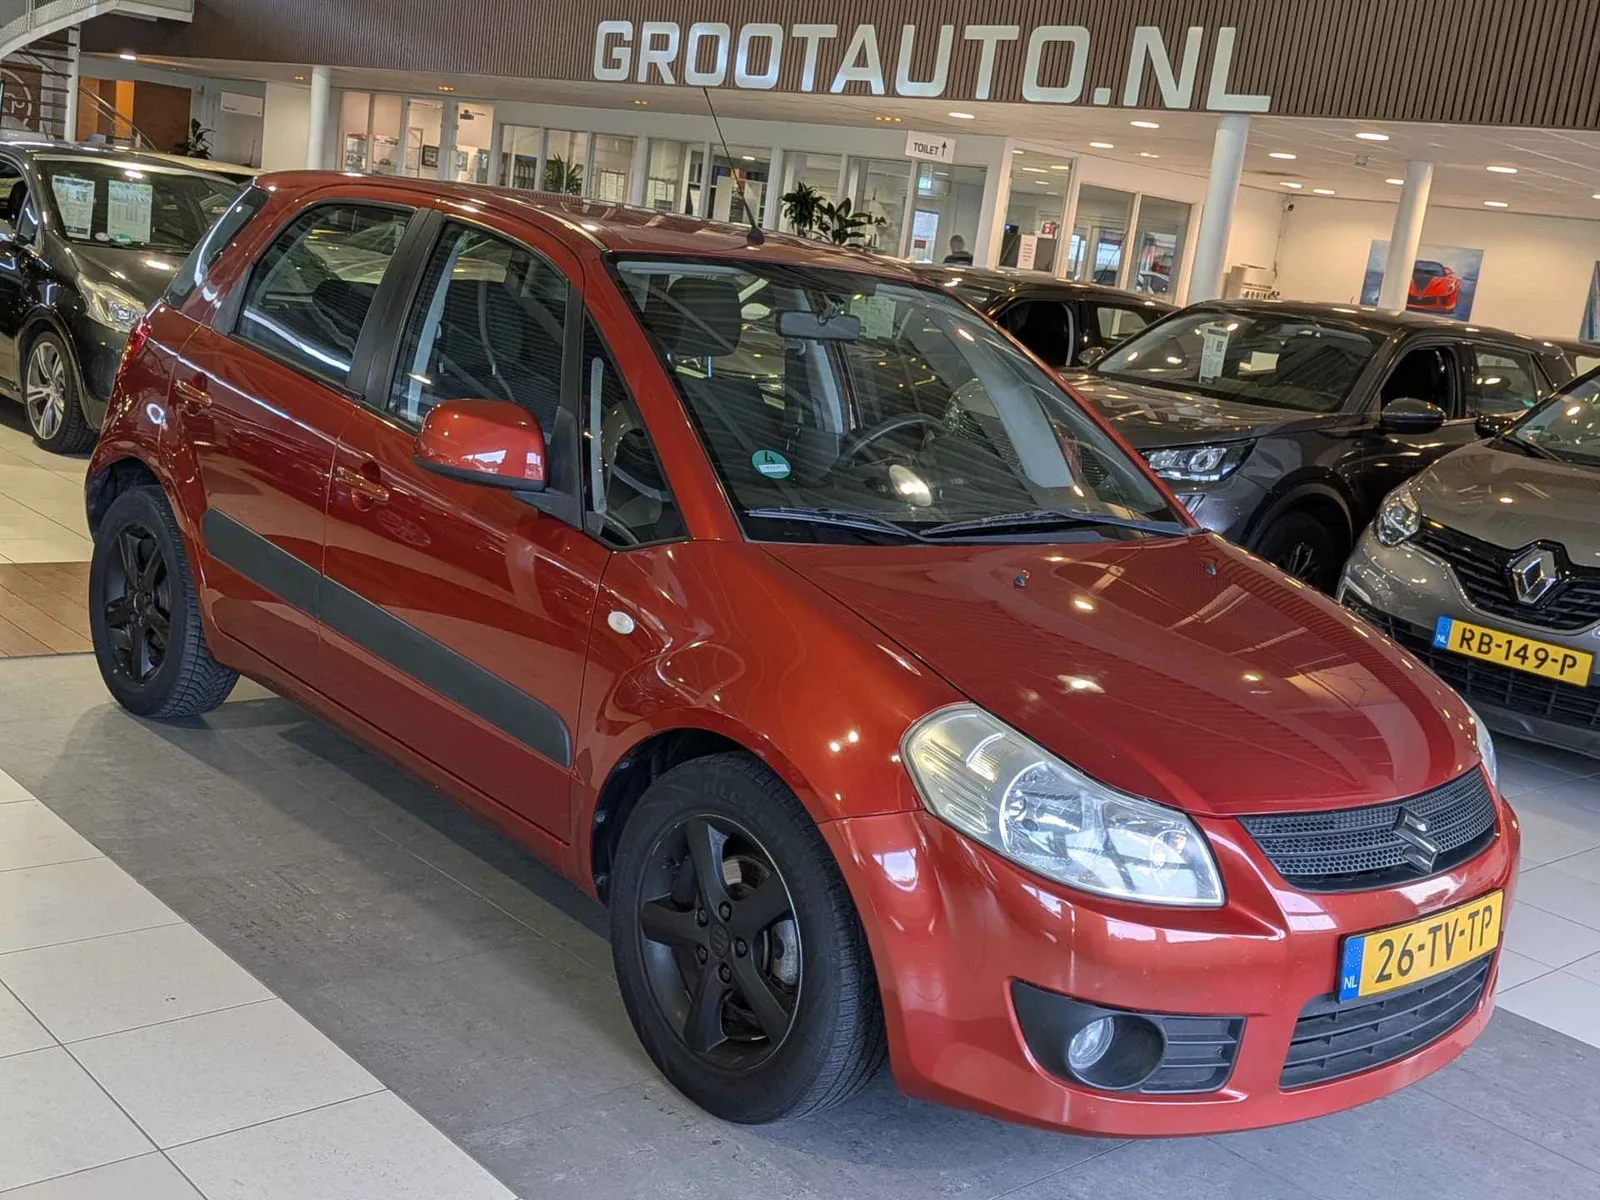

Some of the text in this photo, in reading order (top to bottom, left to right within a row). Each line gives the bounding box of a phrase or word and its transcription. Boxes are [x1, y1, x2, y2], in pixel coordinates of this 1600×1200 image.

[593, 20, 1271, 112] GROOTAUTO.NL
[914, 142, 939, 155] TOILET
[1436, 634, 1447, 644] NL
[1459, 627, 1577, 676] RB-149-P
[1375, 905, 1493, 984] 26-TV-TP
[1343, 976, 1358, 990] NL
